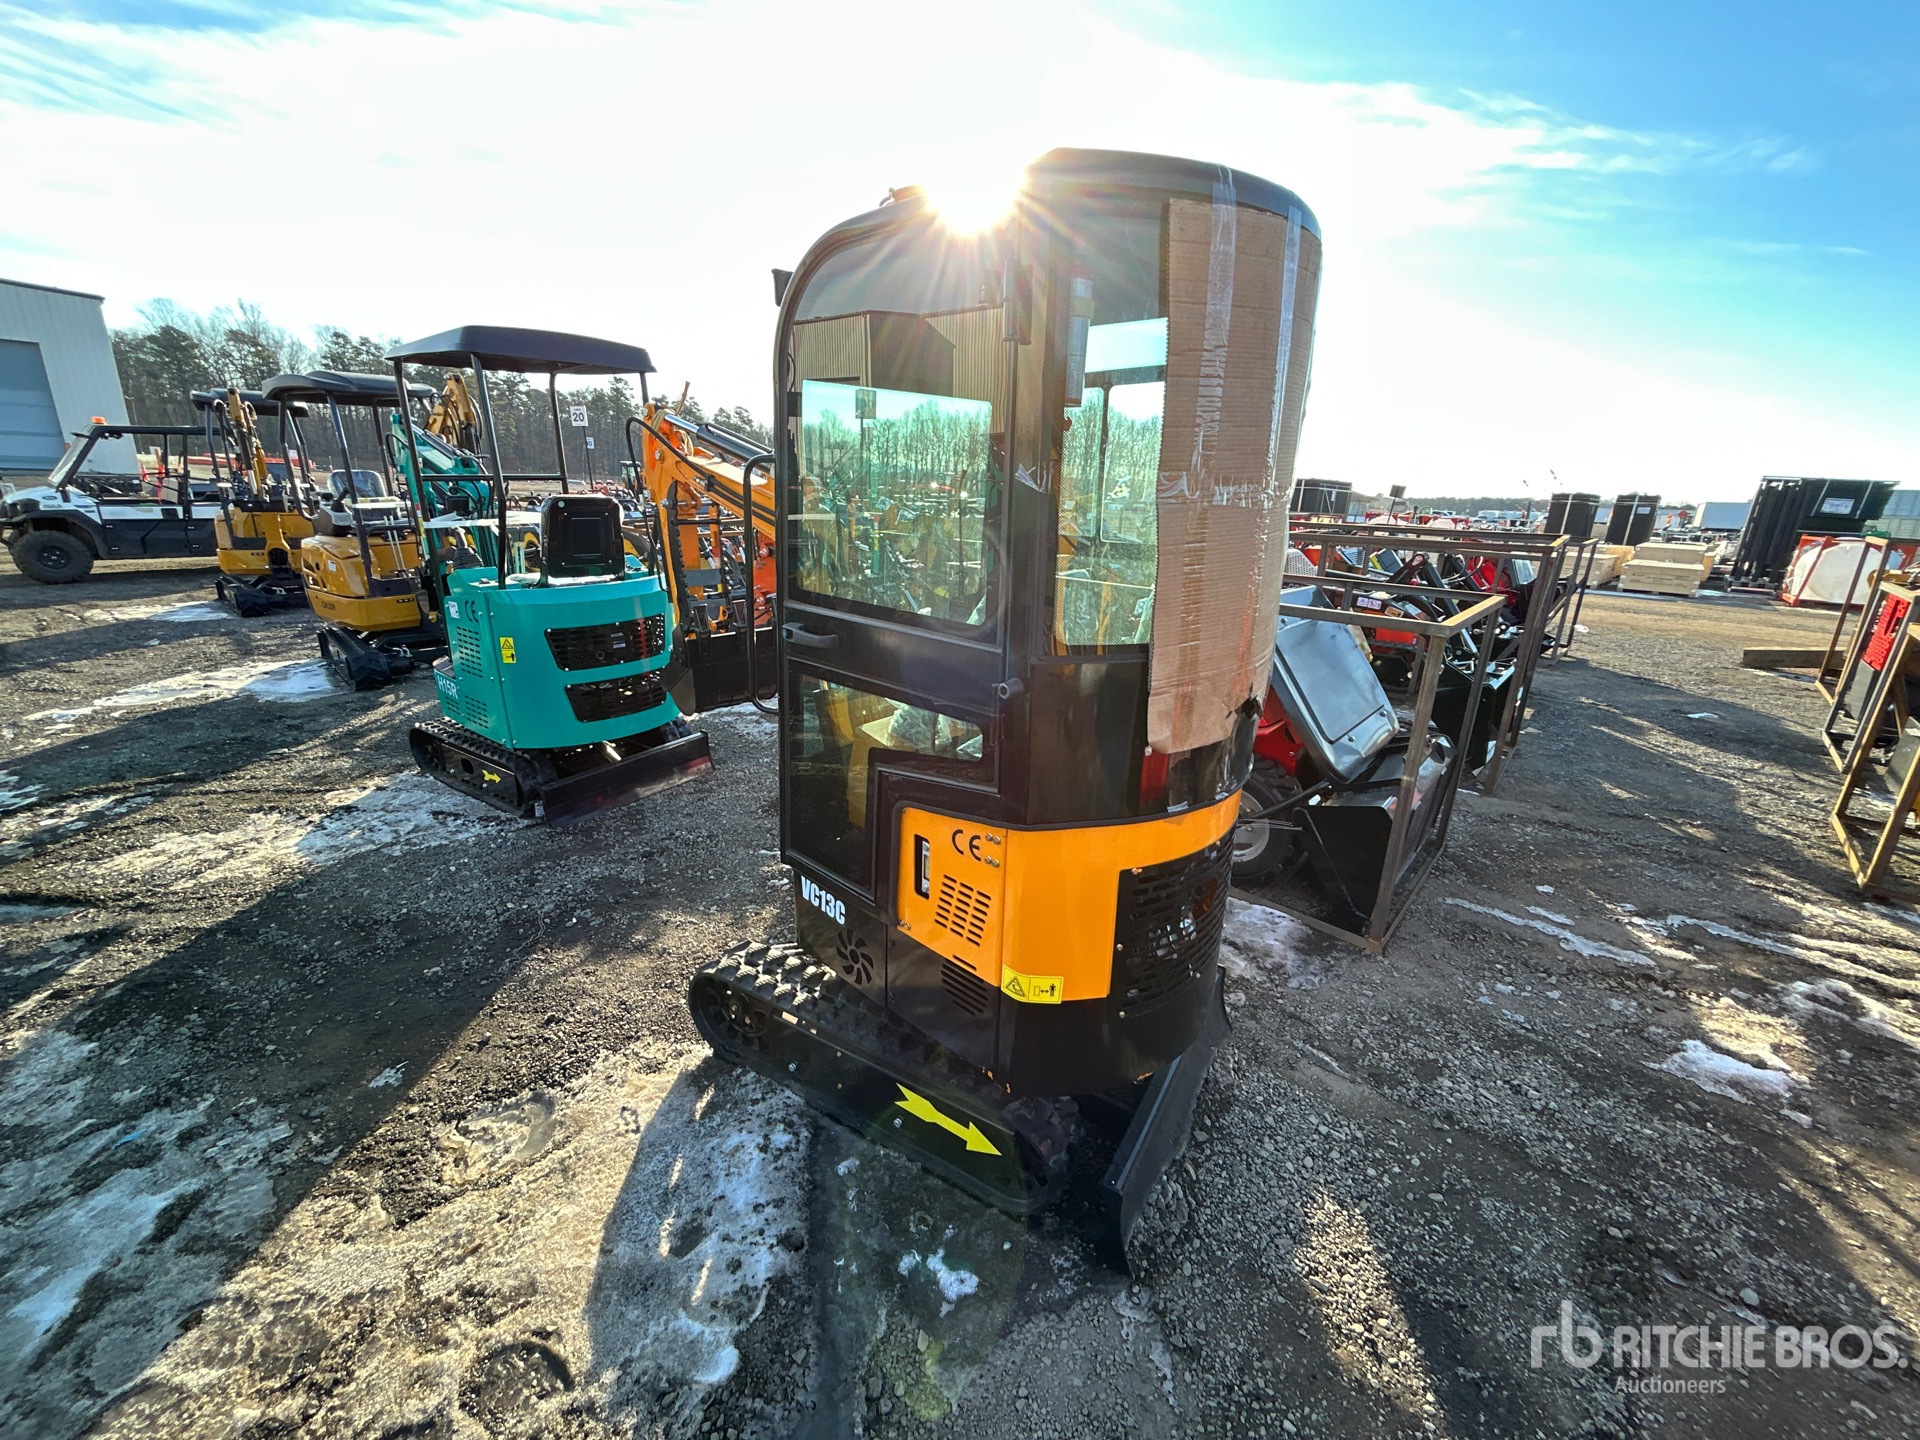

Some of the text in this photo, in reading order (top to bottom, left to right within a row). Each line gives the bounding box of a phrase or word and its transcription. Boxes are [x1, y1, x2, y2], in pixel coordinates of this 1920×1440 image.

[572, 412, 585, 422] 20
[437, 674, 459, 700] H15R
[951, 829, 982, 862] CE
[800, 875, 846, 925] VC13C
